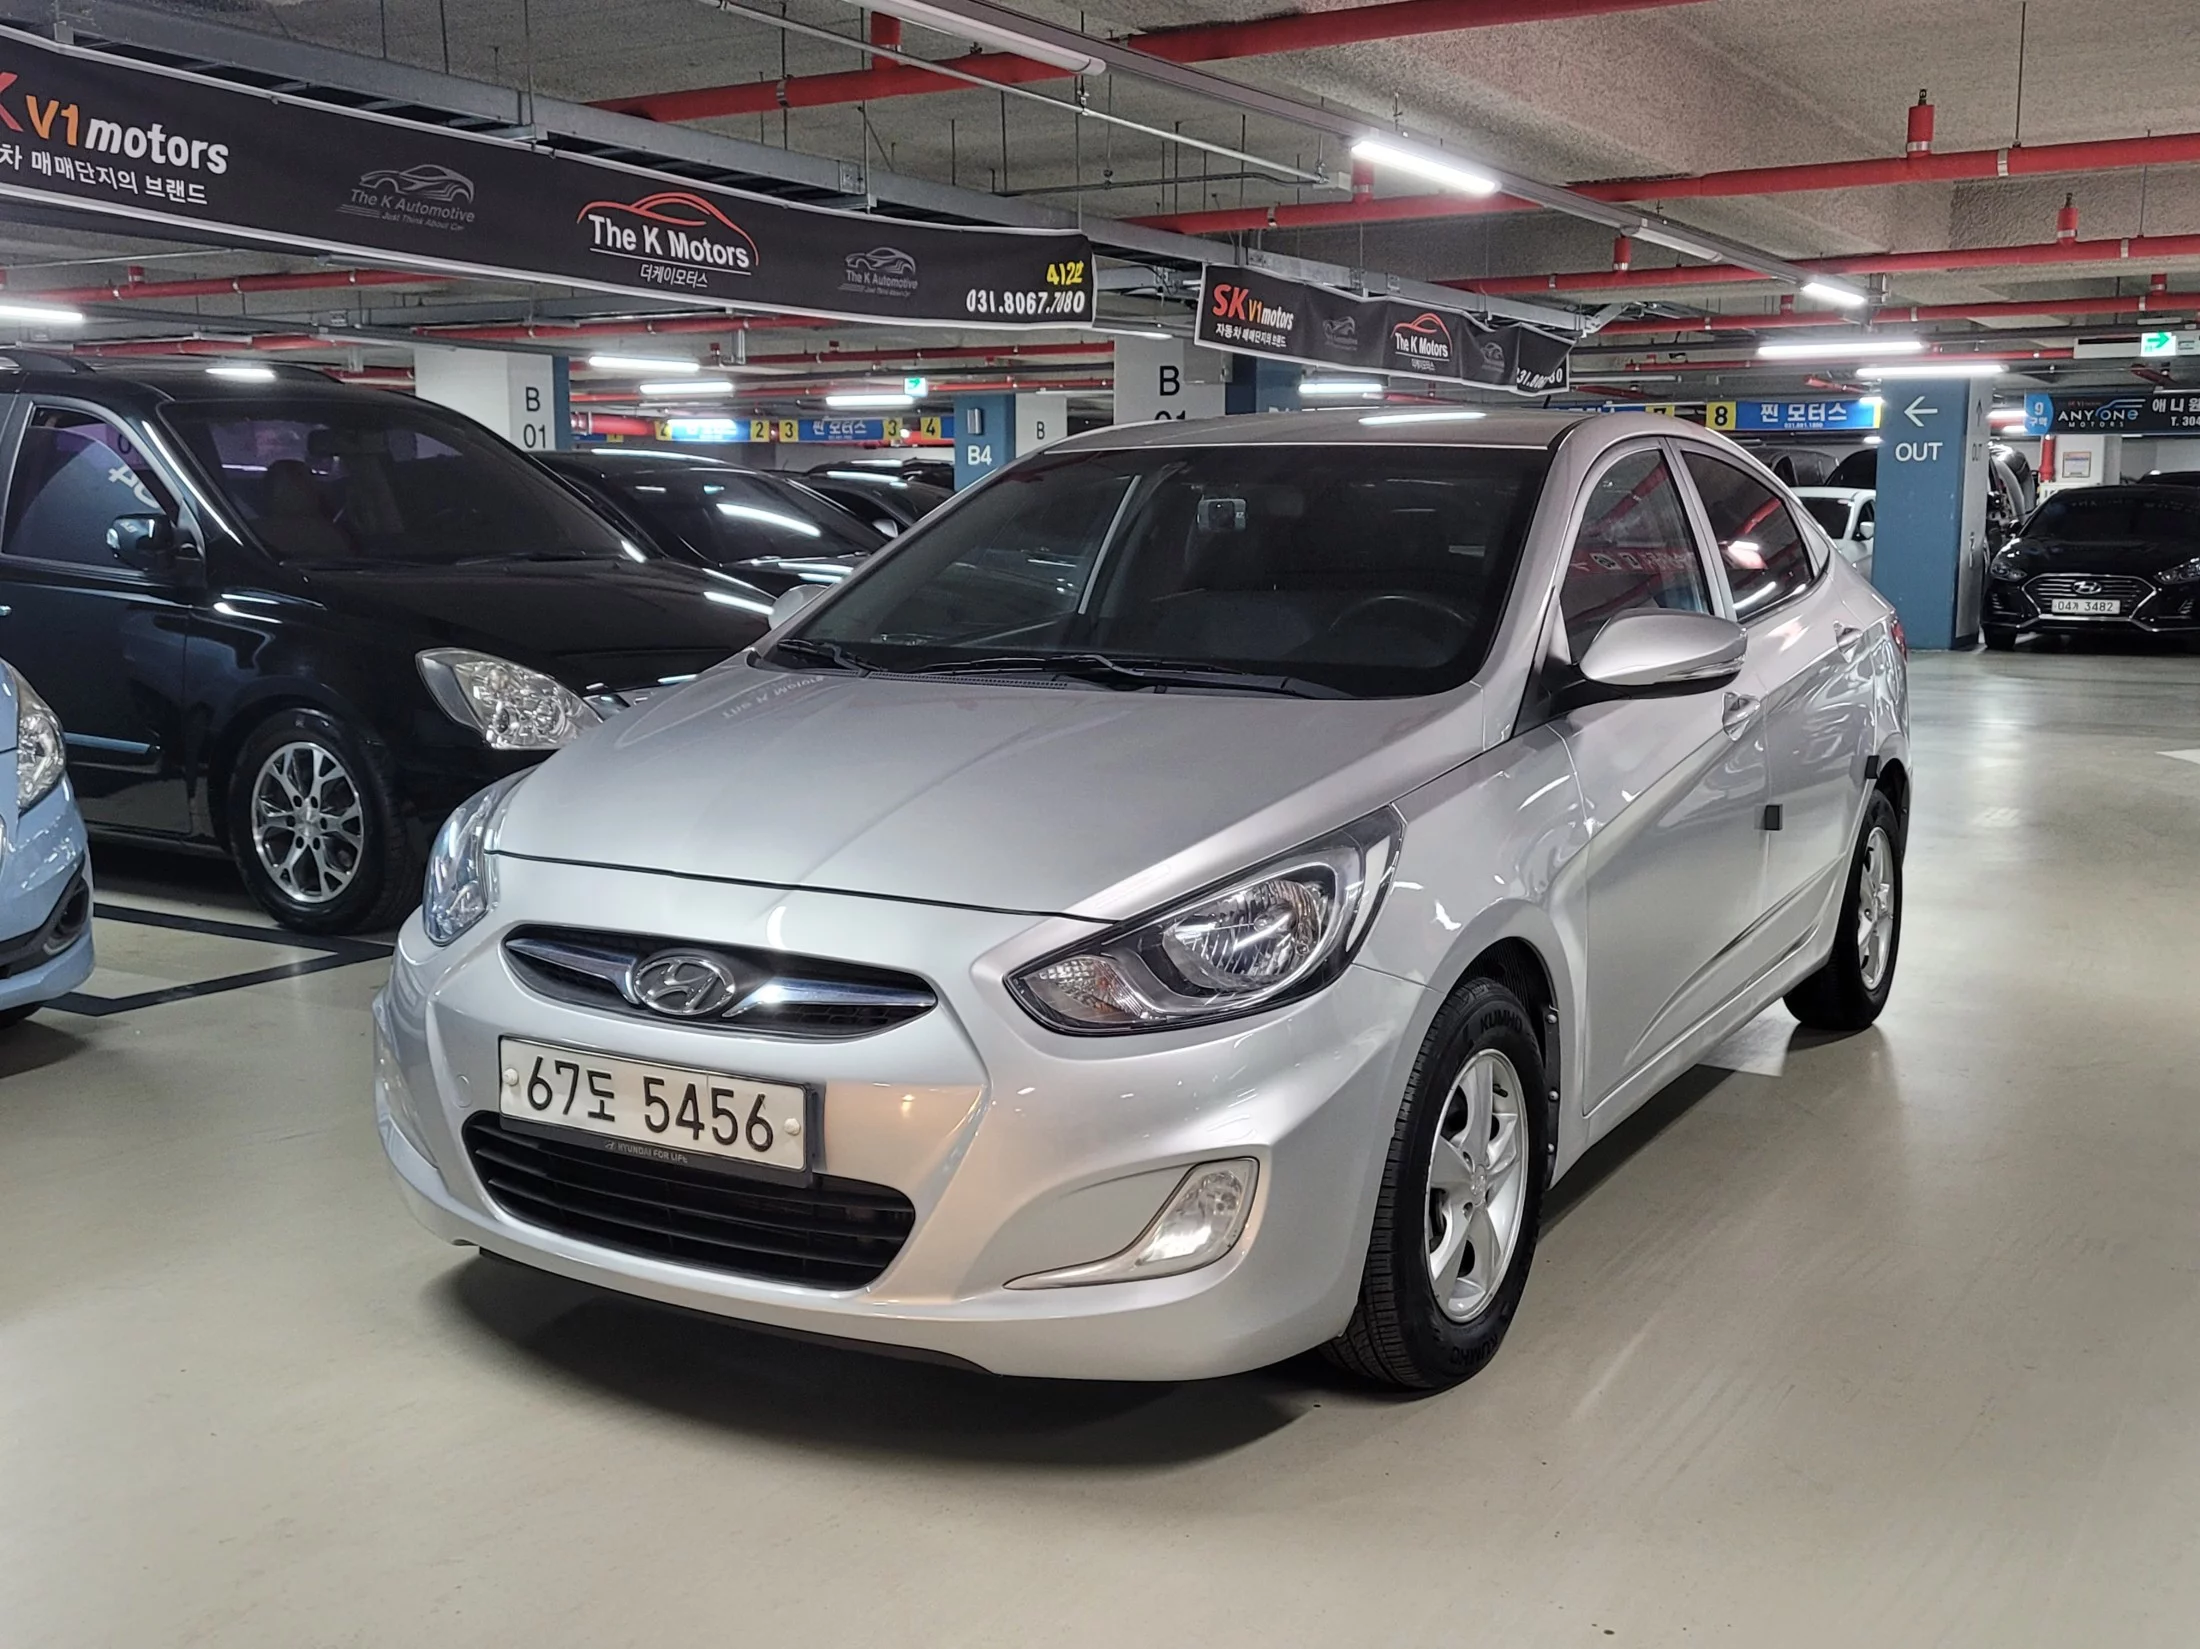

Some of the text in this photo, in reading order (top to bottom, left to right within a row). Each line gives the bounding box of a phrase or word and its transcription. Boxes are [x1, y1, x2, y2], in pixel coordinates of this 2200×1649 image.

[31, 151, 138, 195] 매매단지의
[145, 175, 208, 205] 브랜드
[351, 189, 475, 222] The K Automotive
[588, 214, 749, 268] The K Motors
[640, 263, 708, 289] 더케이모터스
[846, 269, 918, 290] The K Automotive
[1212, 283, 1249, 321] SK
[1215, 322, 1242, 340] 자동차
[1395, 332, 1449, 358] The K Motors
[1159, 365, 1180, 397] B
[526, 386, 541, 412] B
[2034, 401, 2044, 416] 9
[1714, 405, 1728, 427] 8
[1760, 401, 1848, 423] 찐 모터스
[2029, 415, 2048, 428] 구역
[2171, 416, 2180, 427] T.
[523, 423, 546, 449] 01
[755, 421, 764, 438] 2
[784, 421, 794, 438] 3
[888, 419, 897, 437] 3
[925, 417, 936, 435] 4
[1036, 420, 1046, 440] B
[967, 445, 992, 466] B4
[1895, 442, 1943, 462] OUT
[2084, 601, 2114, 612] 3482
[527, 1055, 774, 1153] 67도 5456
[617, 1142, 652, 1157] HYUNDAI
[653, 1149, 670, 1160] FOR
